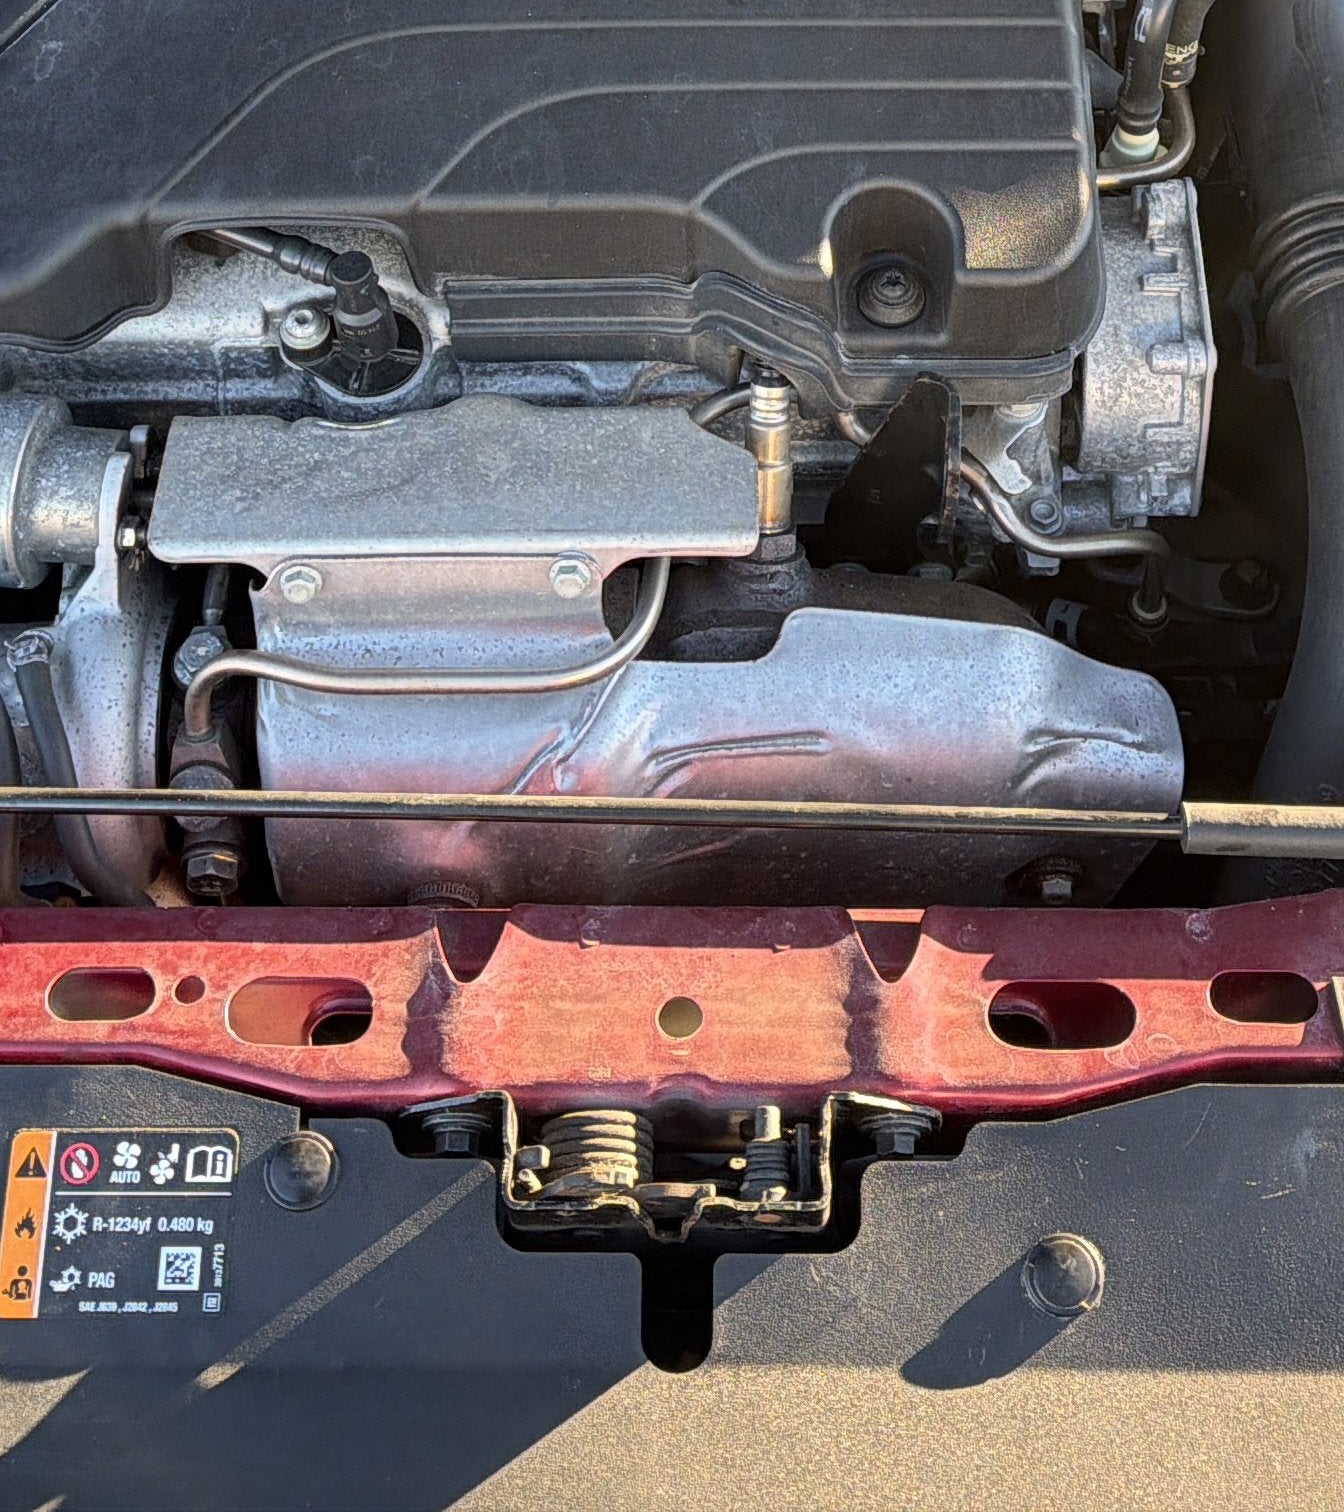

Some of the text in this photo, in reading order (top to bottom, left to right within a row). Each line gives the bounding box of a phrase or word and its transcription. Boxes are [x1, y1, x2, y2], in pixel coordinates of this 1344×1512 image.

[109, 1171, 141, 1184] AUTO
[92, 1217, 214, 1235] R-1234yf 0.480 kg
[88, 1272, 116, 1289] PAG
